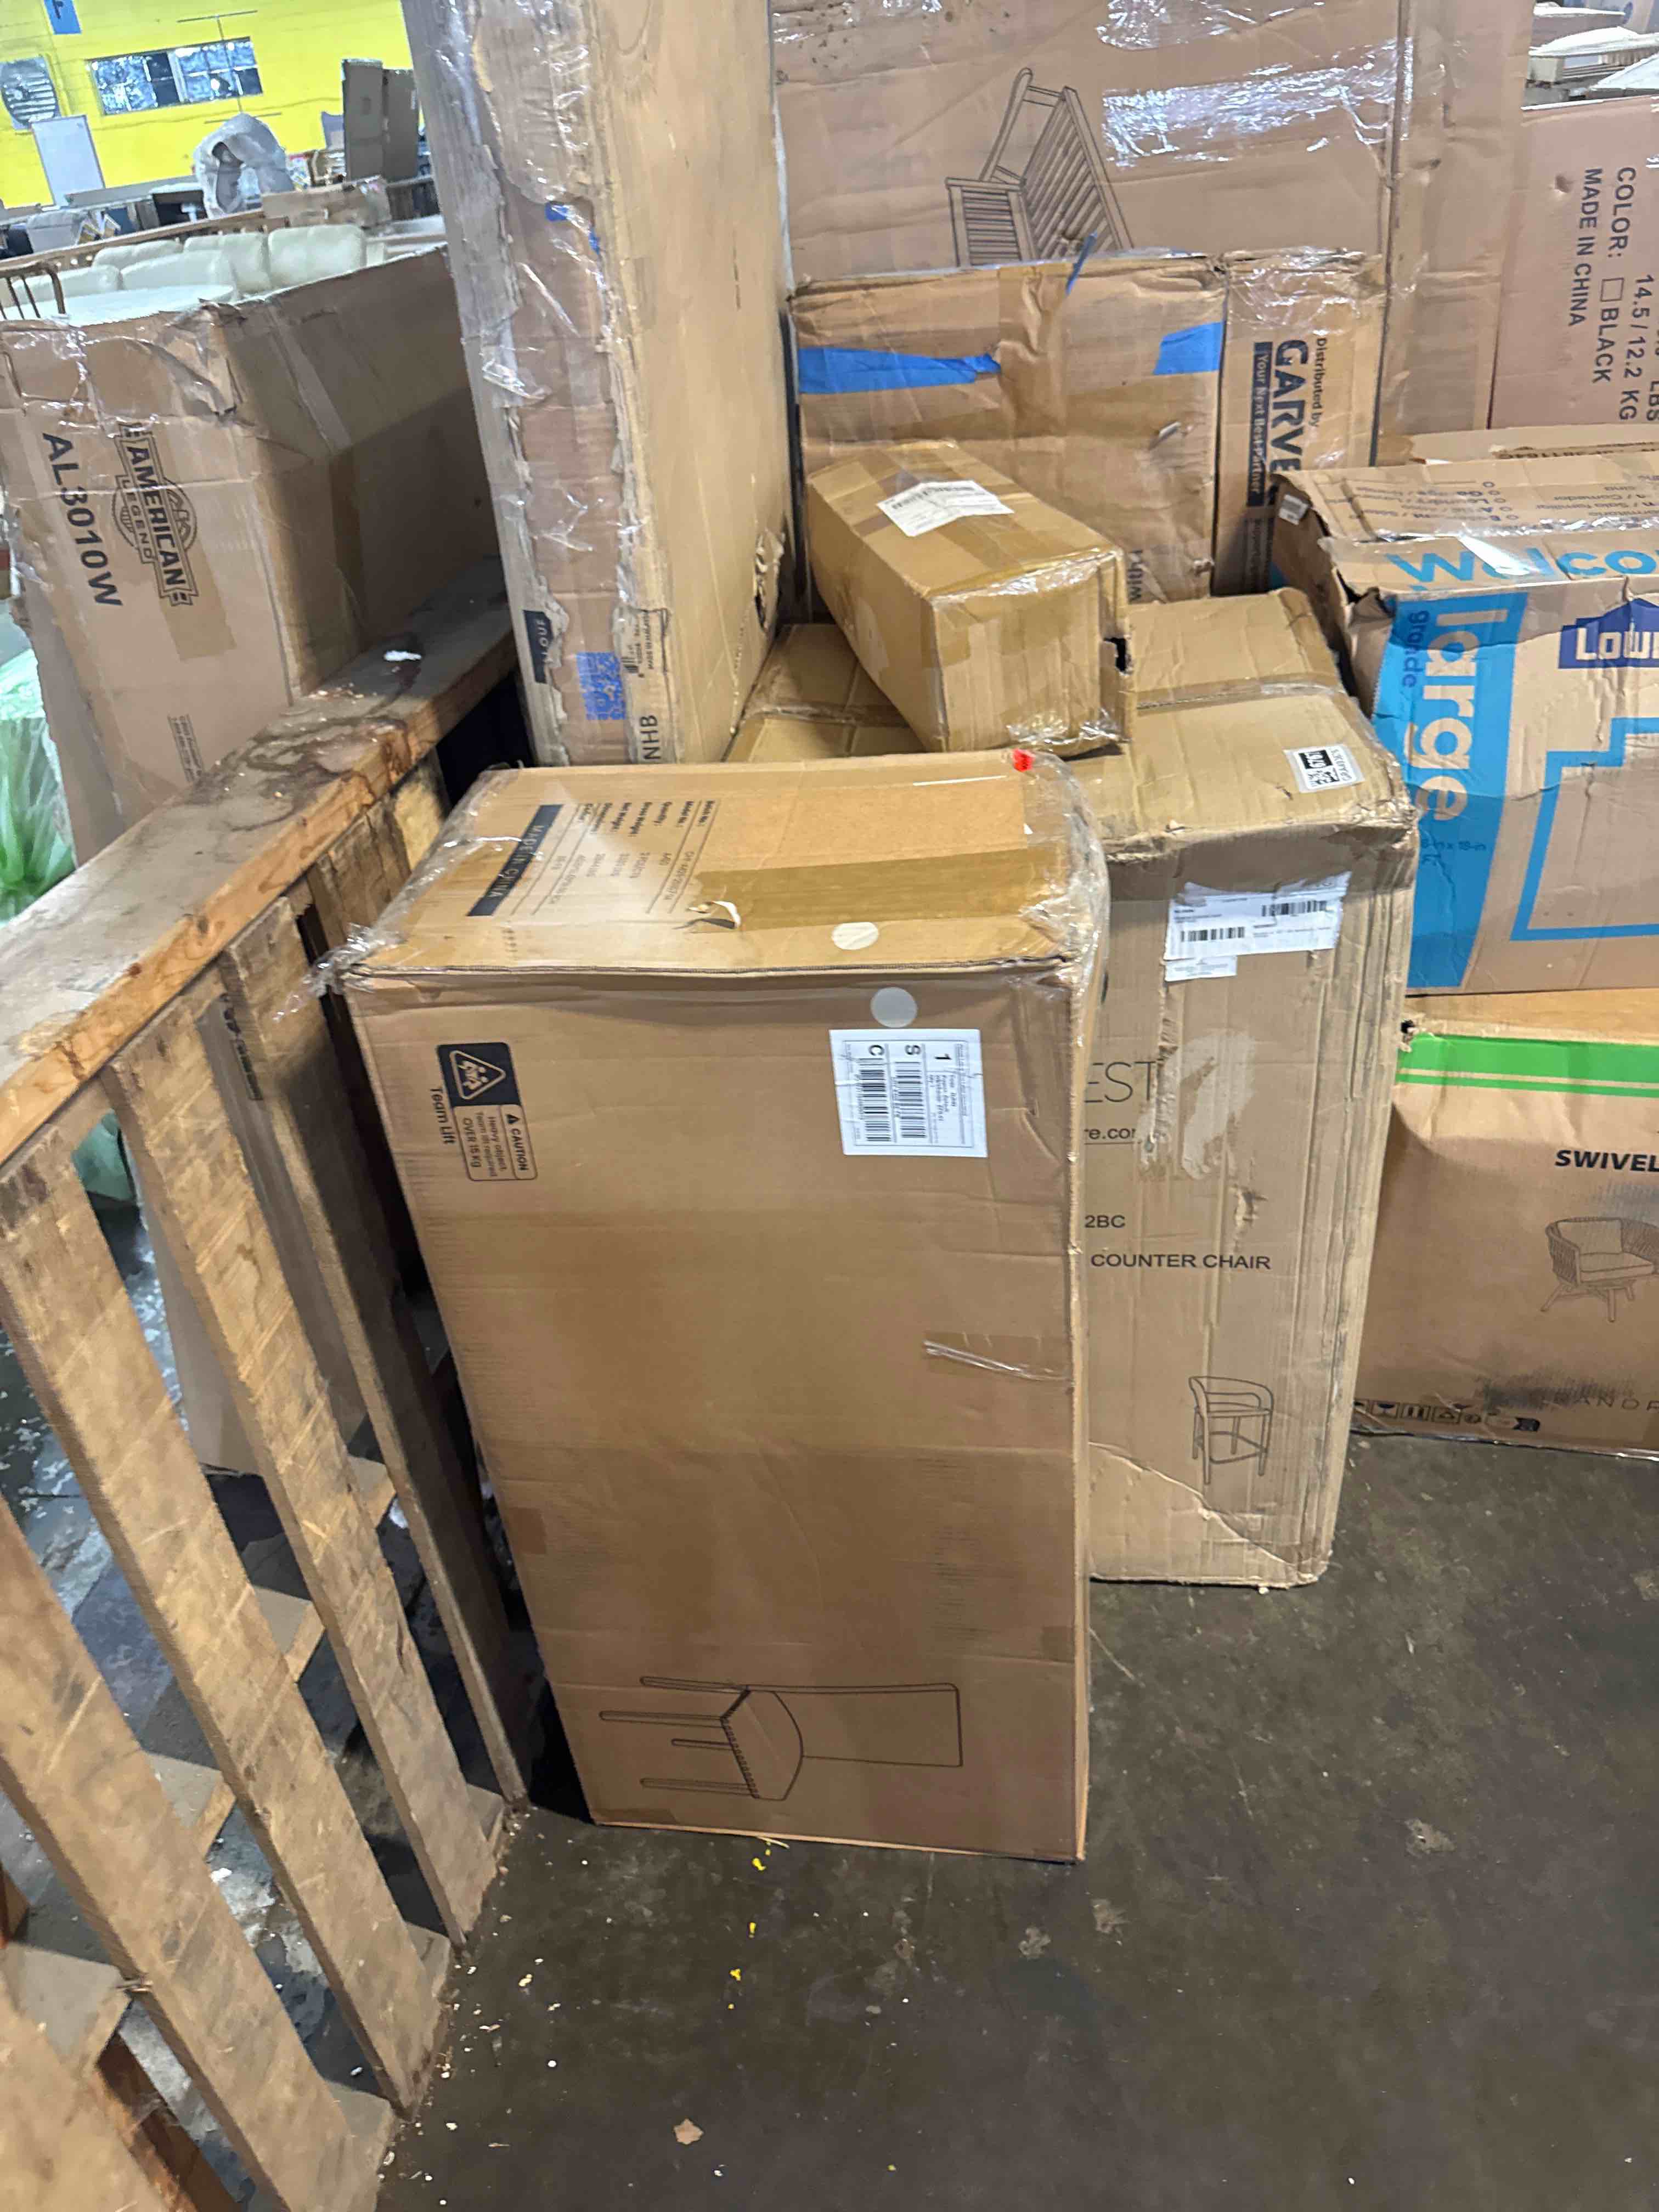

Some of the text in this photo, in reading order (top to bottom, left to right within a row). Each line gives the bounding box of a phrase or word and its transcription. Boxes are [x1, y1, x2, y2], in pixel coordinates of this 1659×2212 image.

[1568, 167, 1603, 327] MADE IN CHINA
[1592, 166, 1637, 383] COLOR: BLACK
[1632, 274, 1655, 319] 14.5
[1256, 354, 1269, 383] Your
[1623, 336, 1647, 379] 12.2
[1308, 337, 1327, 427] Distributed by
[1618, 389, 1640, 421] KG
[43, 432, 124, 607] AL3010W
[121, 479, 155, 560] LEGEND
[126, 445, 188, 586] AMERICAN
[1402, 610, 1430, 688] grande
[1404, 609, 1509, 821] large
[639, 714, 662, 761] NHB
[509, 854, 529, 865] IN
[517, 825, 545, 851] MADE
[486, 868, 520, 899] CHINA
[868, 1044, 885, 1057] C
[905, 1045, 922, 1056] S
[430, 1087, 457, 1145] Team Lift
[510, 1128, 529, 1171] CAUTION
[1554, 1149, 1659, 1173] SWIVEL
[1090, 1254, 1272, 1270] COUNTER CHAIR
